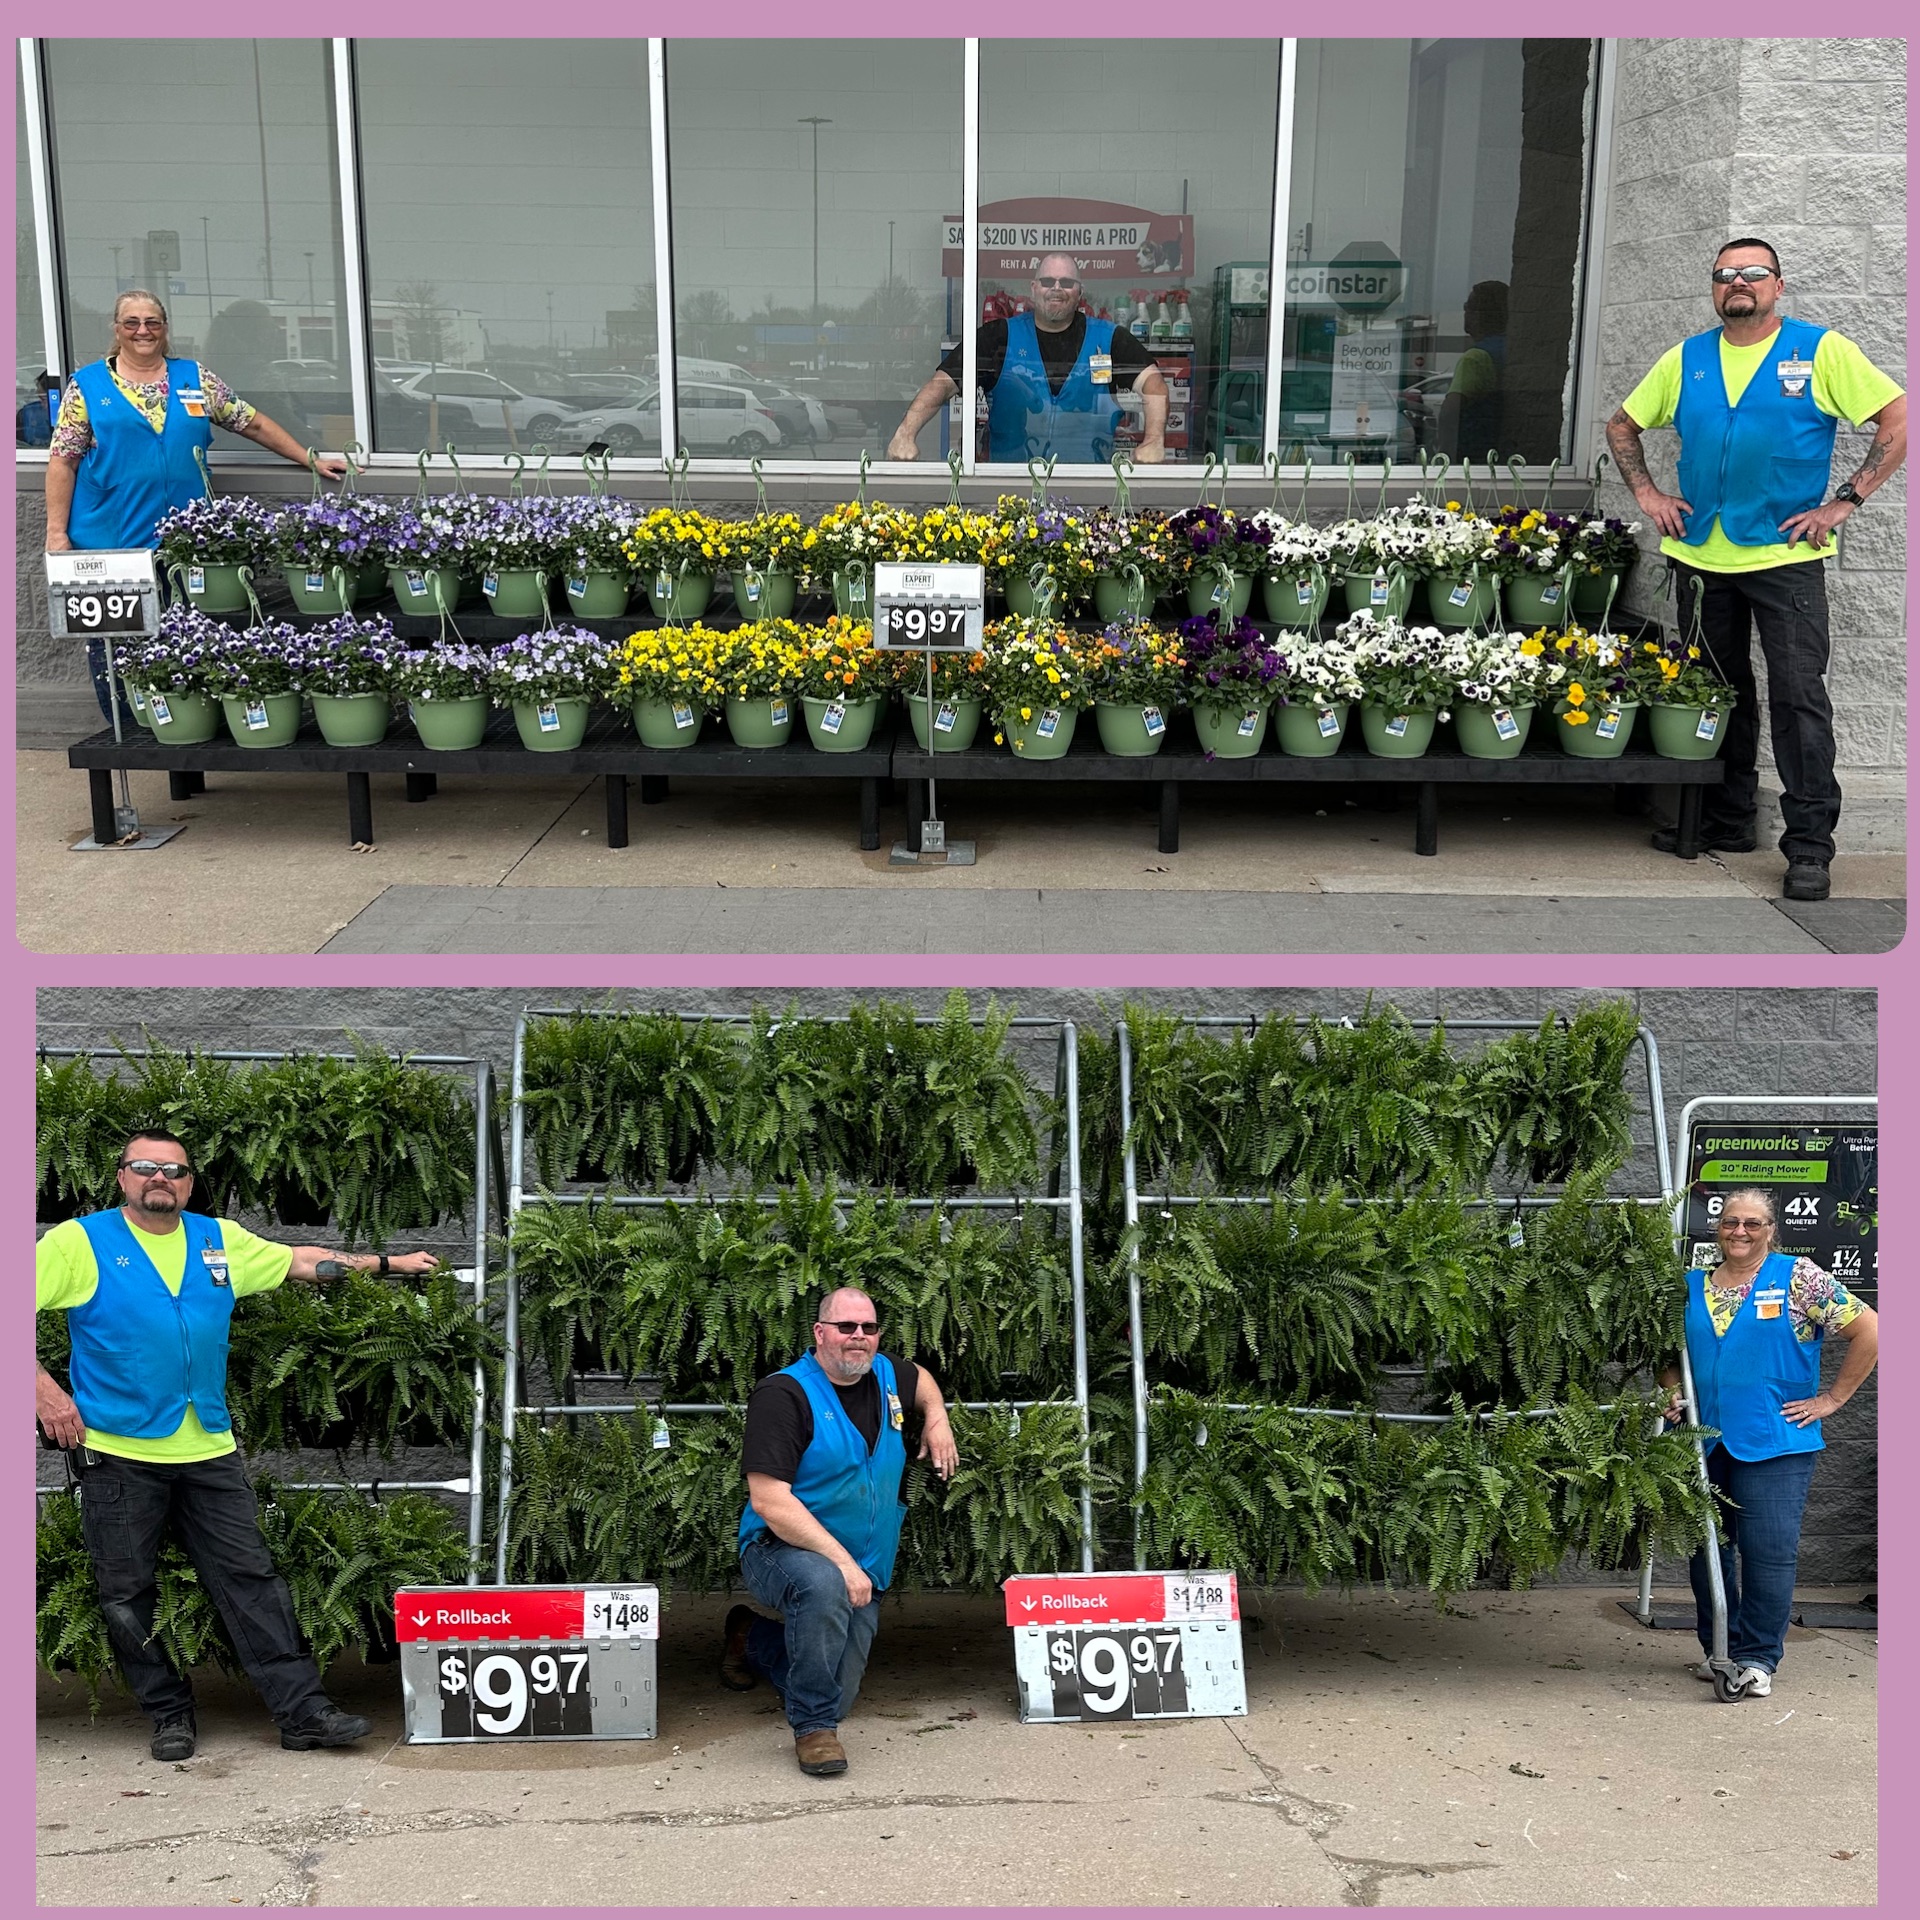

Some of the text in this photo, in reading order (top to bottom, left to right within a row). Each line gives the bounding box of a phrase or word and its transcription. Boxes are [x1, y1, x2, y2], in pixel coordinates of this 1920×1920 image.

[948, 226, 1137, 247] SA $200 VS HIRING A PRO
[1000, 259, 1020, 269] RENT
[1021, 259, 1027, 269] A
[1092, 259, 1116, 270] TODAY
[1286, 271, 1388, 295] coinstar
[1341, 343, 1391, 358] Beyond
[1340, 359, 1393, 371] the coin
[76, 561, 103, 570] EXPERT
[905, 574, 931, 583] EXPERT
[1705, 1134, 1800, 1155] greenworks
[1842, 1136, 1863, 1144] Ultra
[1849, 1144, 1875, 1152] Better
[1742, 1164, 1774, 1175] Riding
[1776, 1164, 1811, 1173] Mower
[1784, 1197, 1821, 1216] 4X
[1780, 1246, 1817, 1254] DELIVERY
[1831, 1268, 1860, 1276] ACRES
[611, 1591, 633, 1602] Was:
[1041, 1593, 1108, 1609] Rollback
[436, 1609, 512, 1625] Rollback
